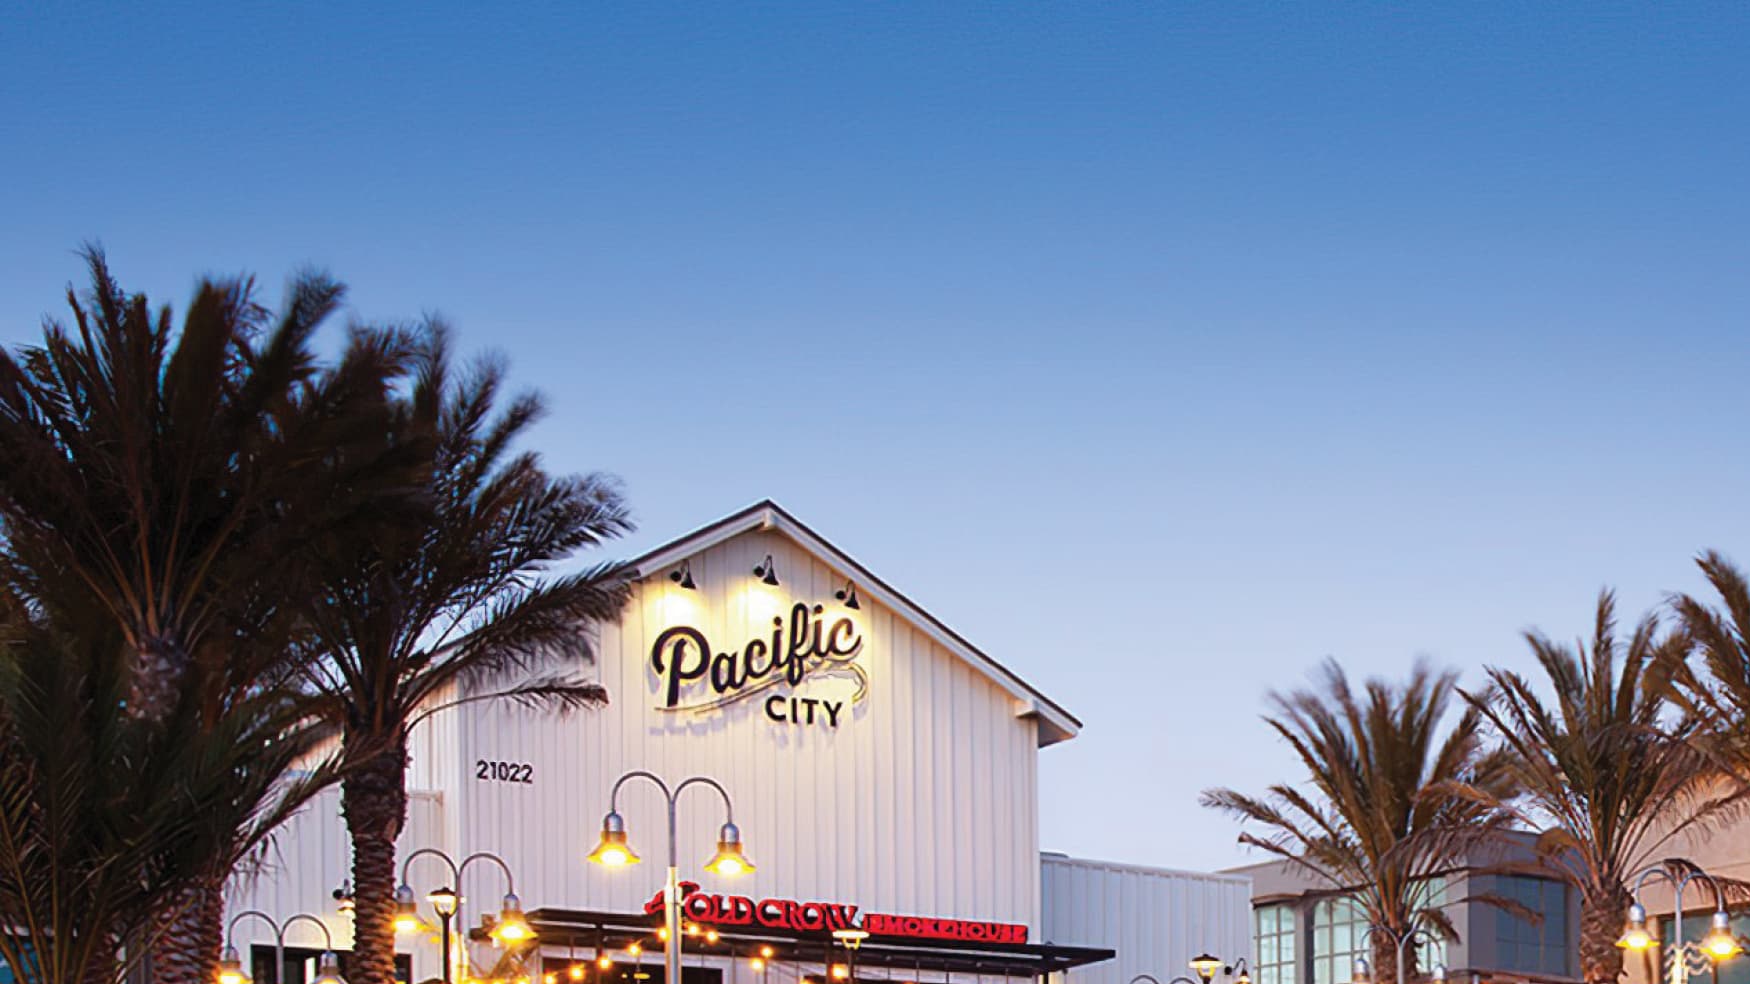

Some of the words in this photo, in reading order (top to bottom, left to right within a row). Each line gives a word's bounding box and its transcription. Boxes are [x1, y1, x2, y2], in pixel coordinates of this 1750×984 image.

[652, 602, 862, 708] Pacific
[765, 695, 843, 727] CITY
[476, 759, 534, 784] 21022
[684, 893, 753, 925] OLD
[756, 898, 858, 932] CROW
